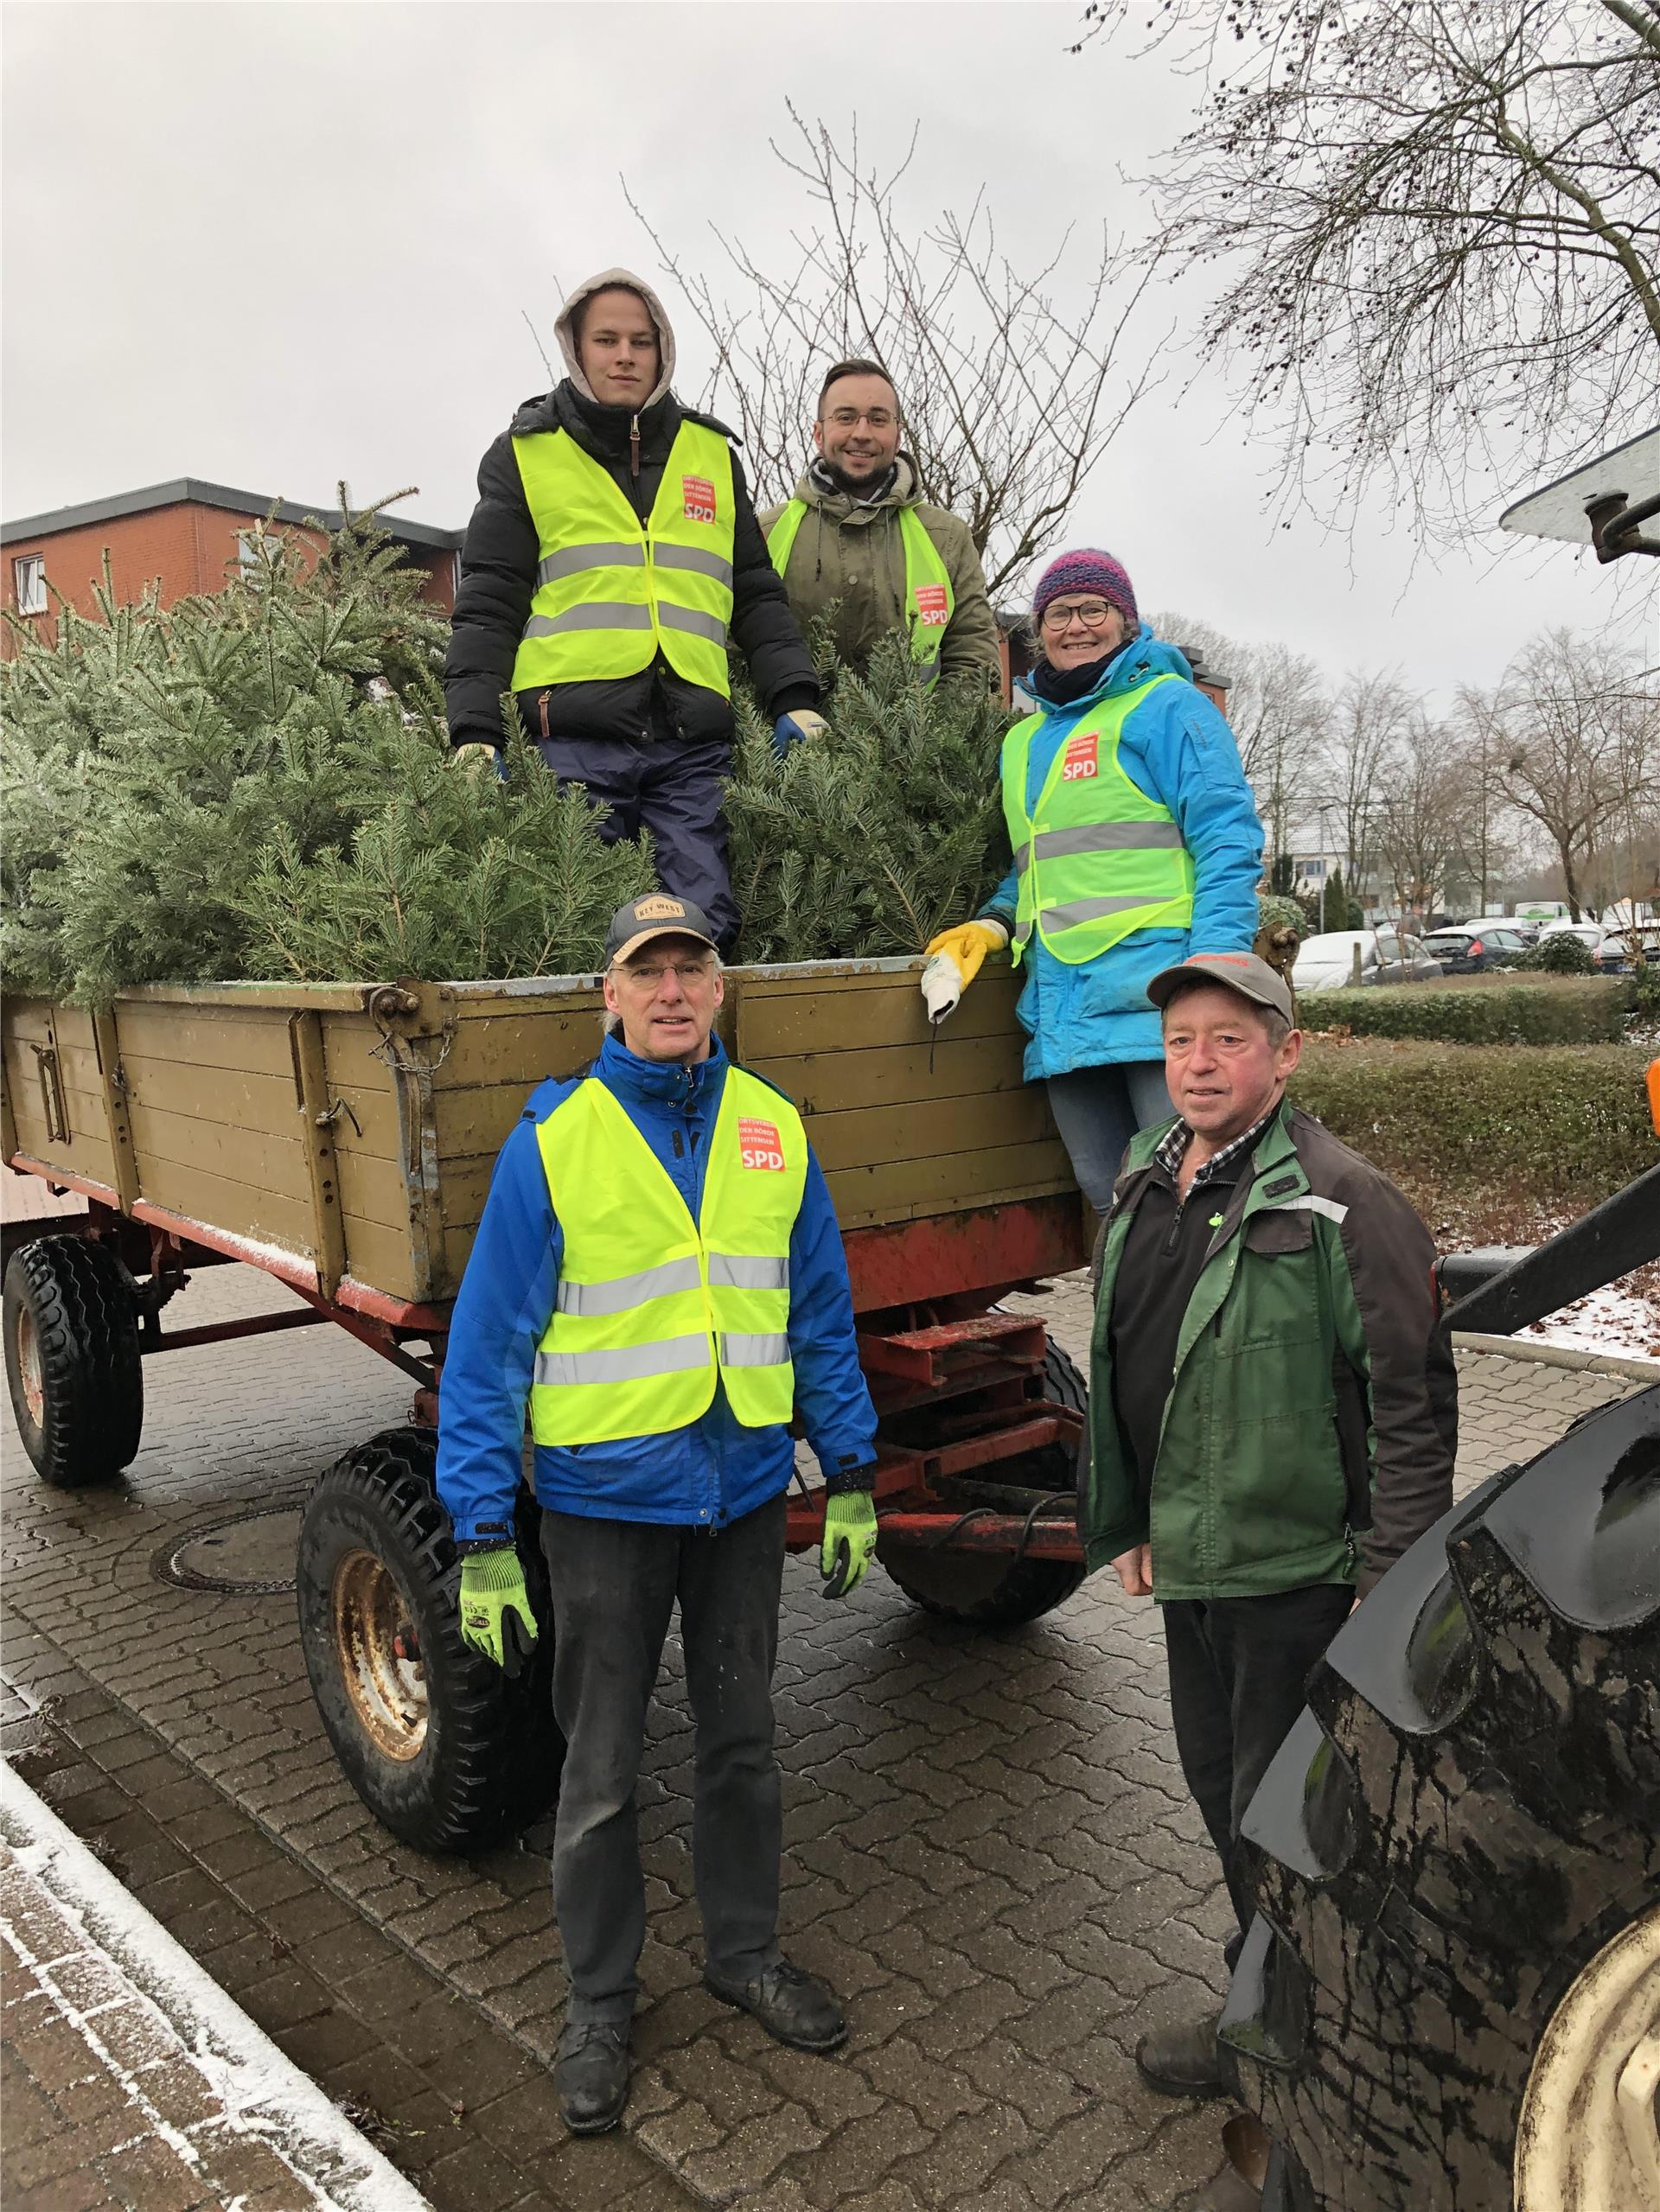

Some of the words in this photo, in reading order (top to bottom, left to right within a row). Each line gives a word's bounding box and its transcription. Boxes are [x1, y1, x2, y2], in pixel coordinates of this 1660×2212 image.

[685, 503, 714, 523] SPD
[922, 609, 948, 625] SPD
[1063, 760, 1096, 781] SPD
[639, 906, 654, 916] KEY
[656, 902, 680, 914] WEST
[742, 1150, 783, 1170] SPD
